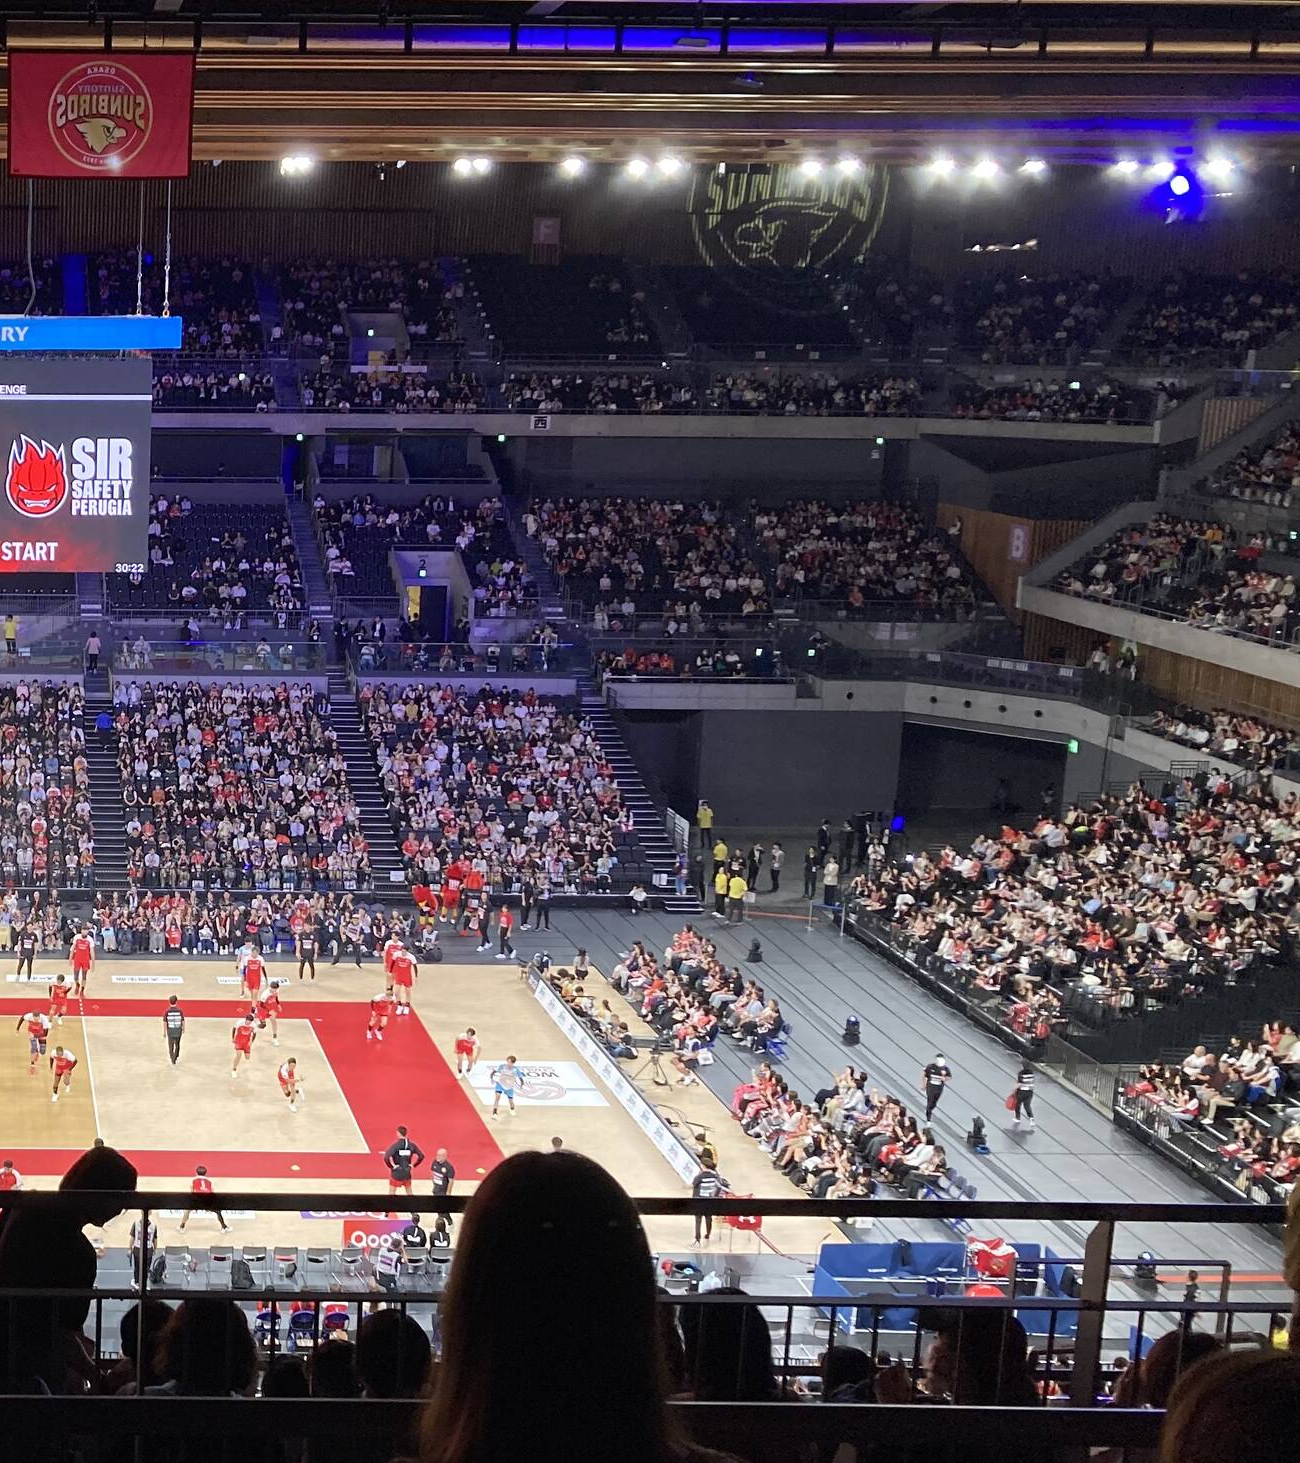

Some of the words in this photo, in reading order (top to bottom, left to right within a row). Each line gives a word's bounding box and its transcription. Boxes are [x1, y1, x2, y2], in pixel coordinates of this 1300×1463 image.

[534, 416, 548, 429] 西
[71, 437, 133, 480] SIR
[71, 480, 133, 499] SAFETY
[71, 499, 133, 516] PERUGIA
[1, 541, 59, 561] START
[1011, 528, 1024, 558] B
[115, 564, 144, 573] 30:22
[419, 559, 427, 569] 2
[350, 1230, 403, 1249] Qoo
